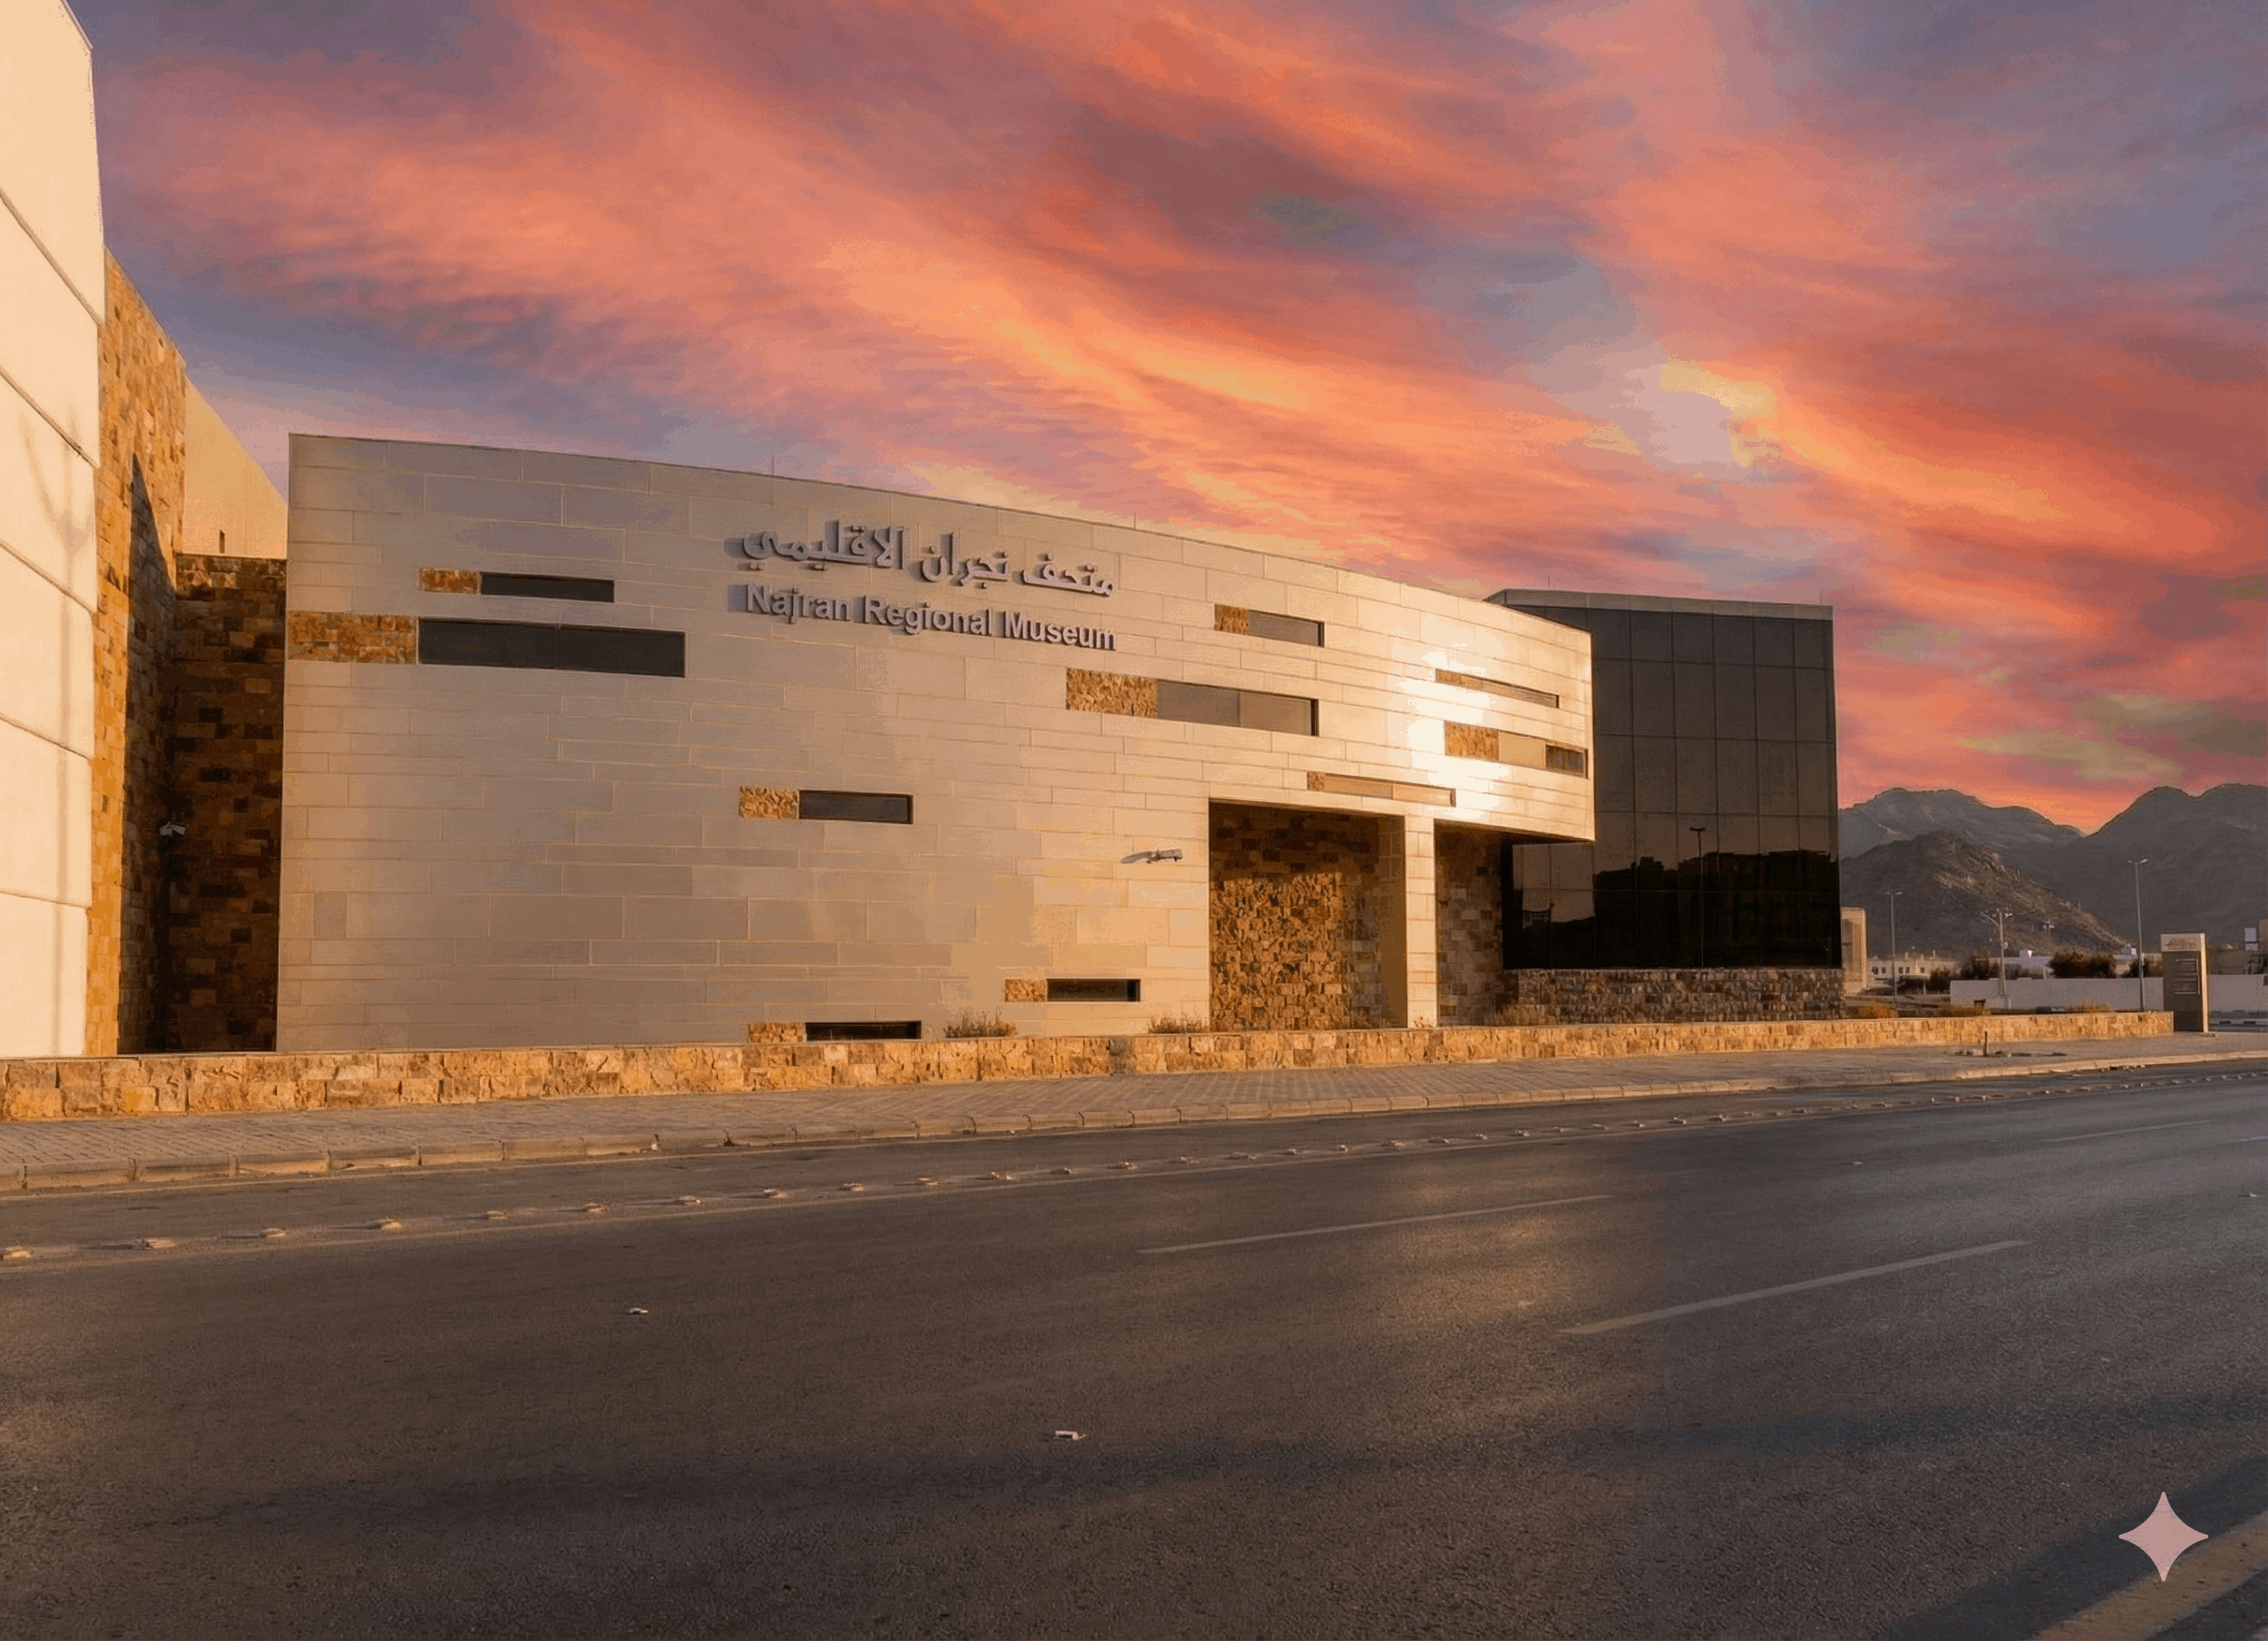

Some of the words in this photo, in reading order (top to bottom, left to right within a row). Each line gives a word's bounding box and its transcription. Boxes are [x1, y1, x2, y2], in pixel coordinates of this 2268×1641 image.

[742, 519, 910, 572] الاقليمي
[920, 532, 1009, 590] نجران
[1022, 552, 1116, 597] متحف
[746, 584, 851, 625] Najran
[864, 594, 992, 635] Regional
[1003, 610, 1117, 651] Museum
